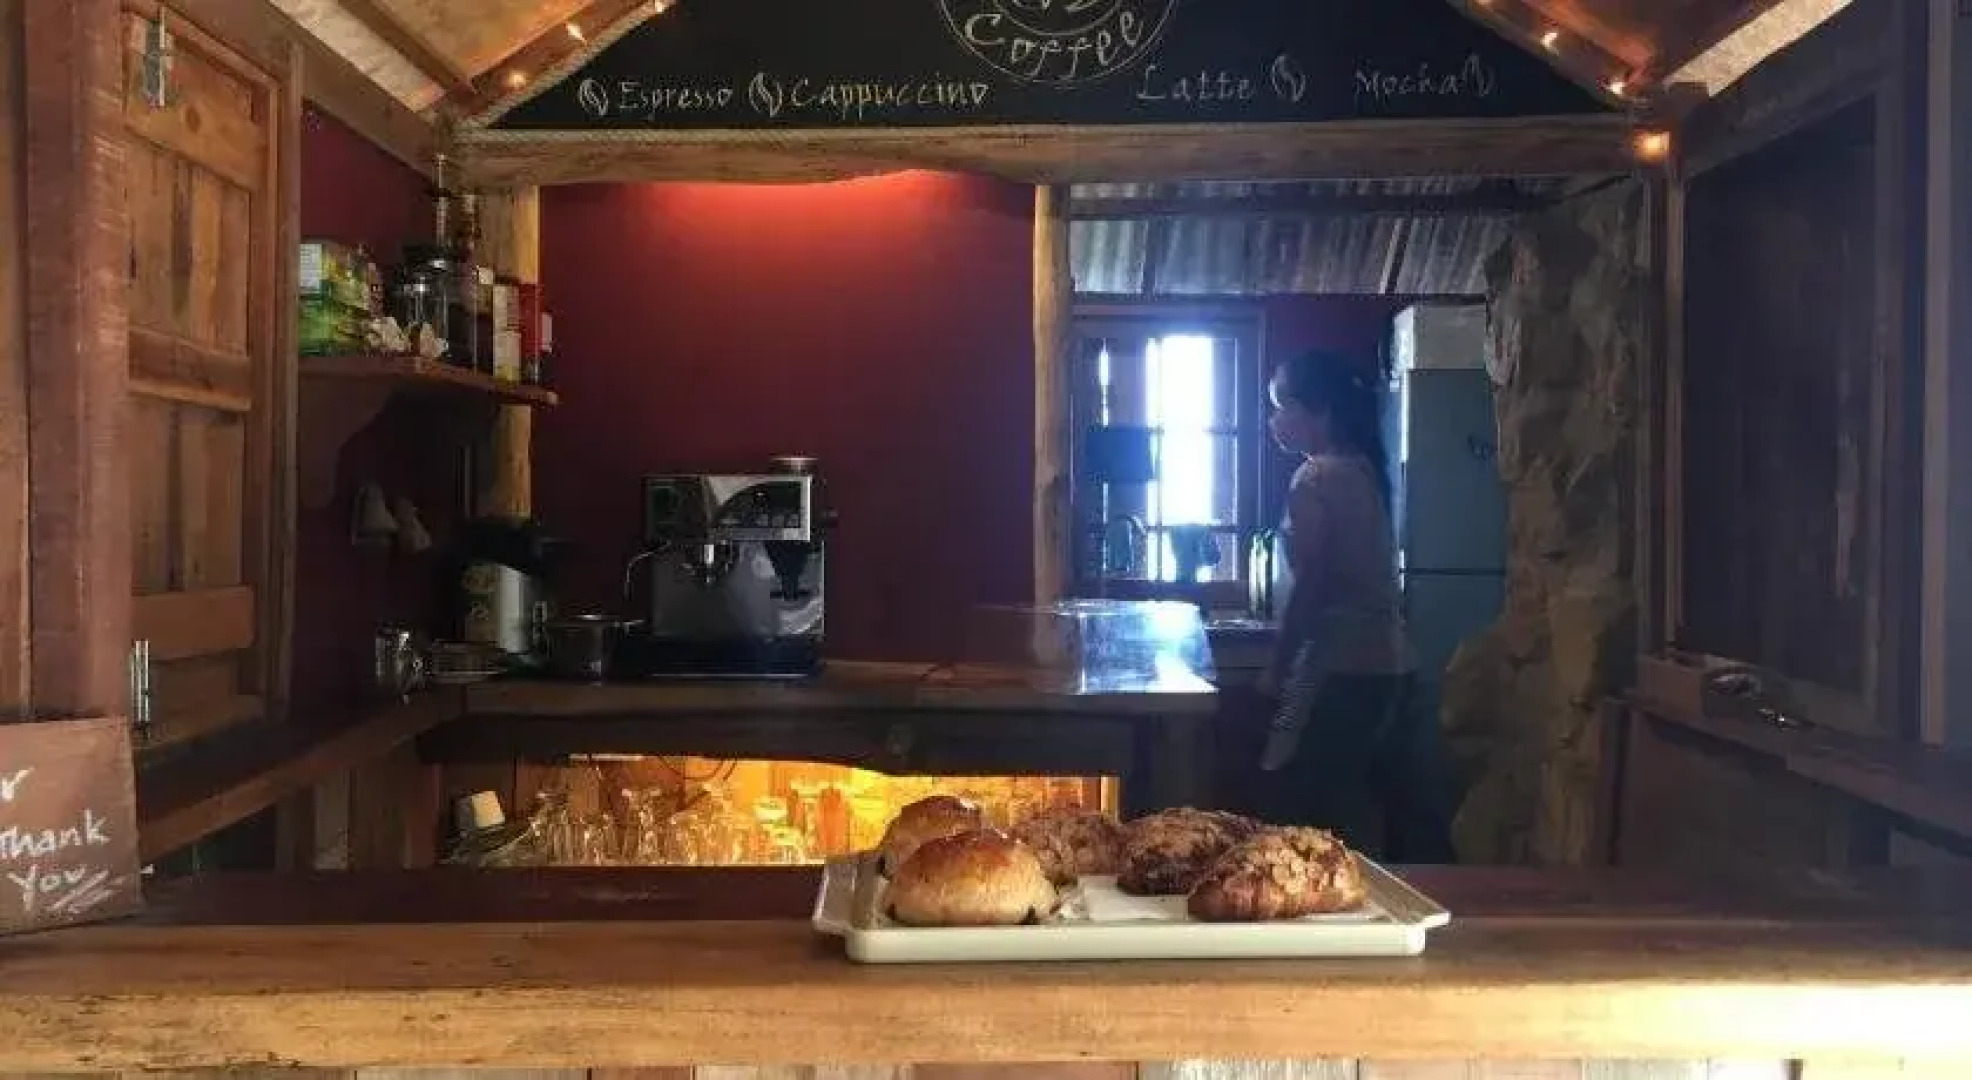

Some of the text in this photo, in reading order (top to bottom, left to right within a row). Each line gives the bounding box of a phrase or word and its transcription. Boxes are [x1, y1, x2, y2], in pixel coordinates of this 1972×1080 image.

[964, 11, 1144, 82] Coffee
[618, 63, 1460, 119] Espresso Cappuccino Latte Mocha
